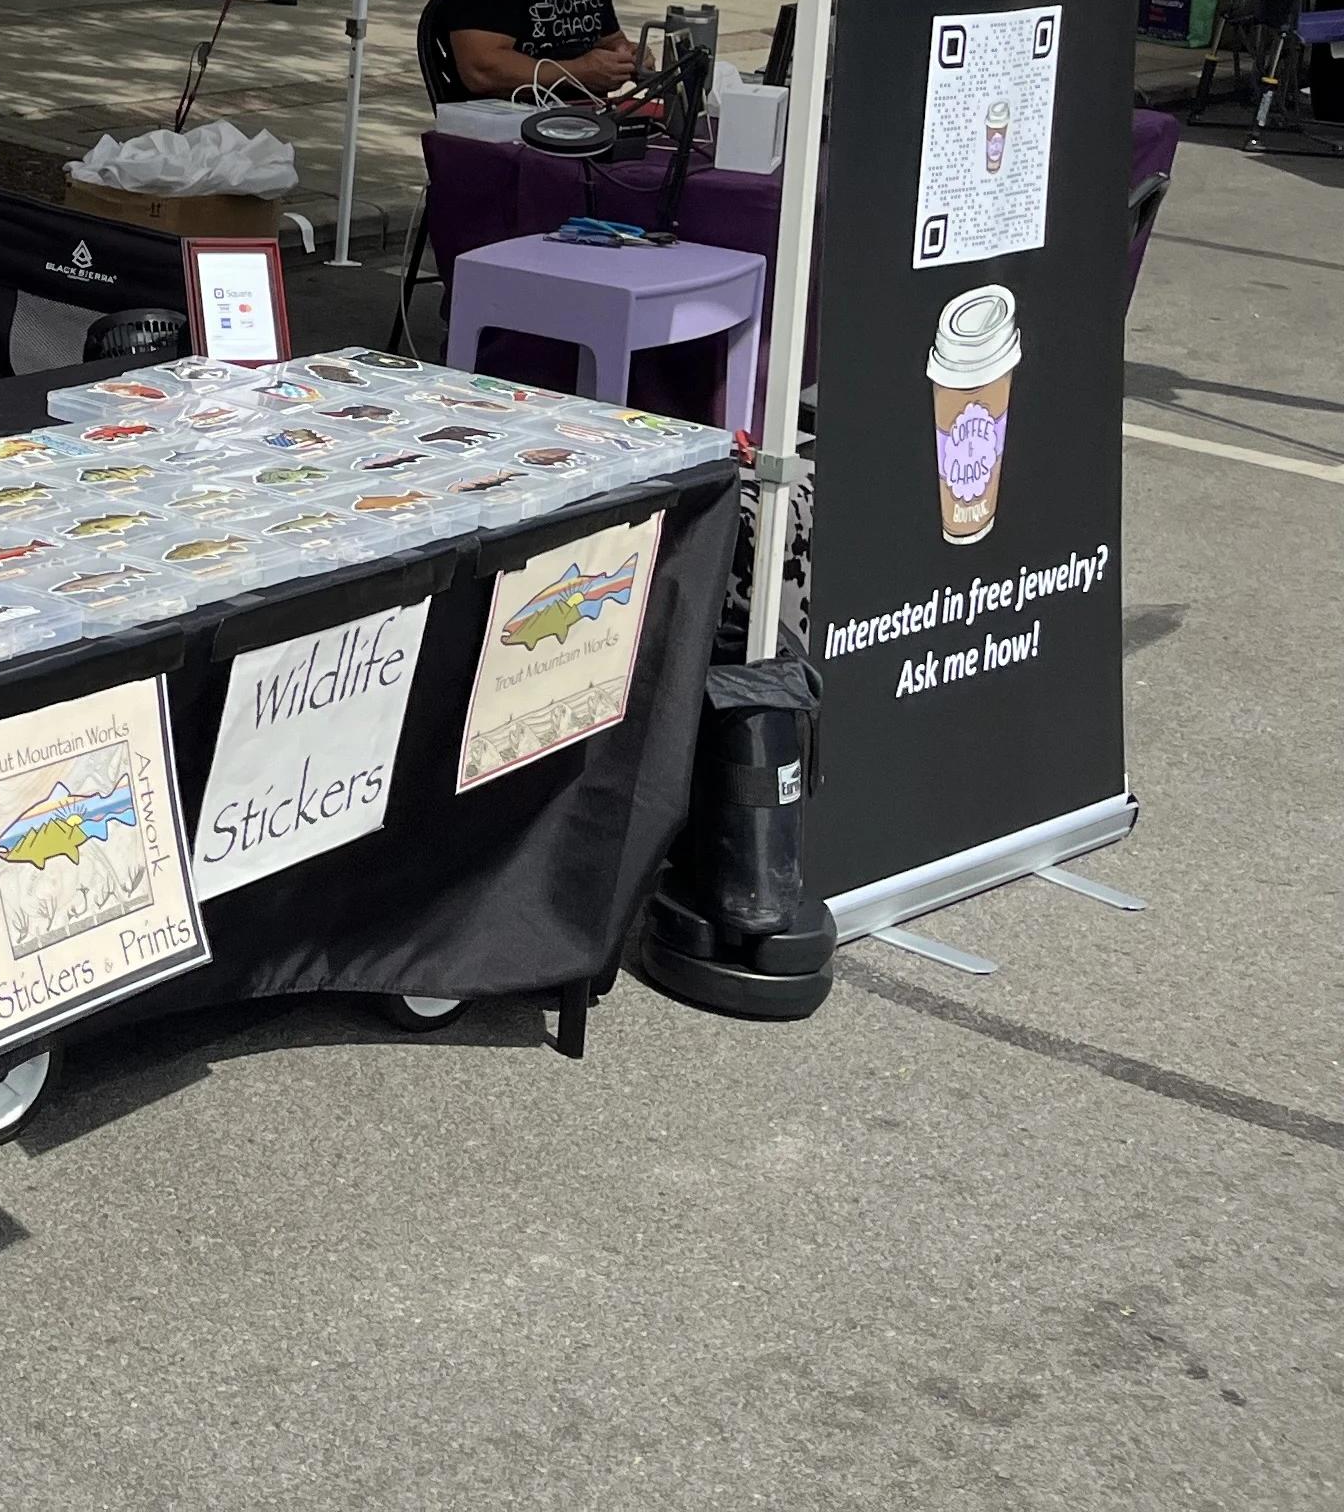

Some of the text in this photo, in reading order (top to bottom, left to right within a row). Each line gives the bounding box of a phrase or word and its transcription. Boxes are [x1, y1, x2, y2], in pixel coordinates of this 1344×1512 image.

[532, 12, 602, 38] & CHAOS
[45, 262, 76, 276] BLACK
[951, 418, 995, 446] COFFEE
[950, 456, 990, 485] CHAOS
[953, 499, 990, 524] BOUTIQUE
[824, 544, 1109, 660] Interested in free jewelry?
[256, 616, 405, 730] Wildlife
[495, 627, 620, 692] Trout Mountain Works
[895, 619, 1041, 699] Ask me how!
[16, 736, 85, 776] Mountain
[84, 714, 130, 746] Works
[133, 750, 171, 878] Artwork
[203, 755, 385, 863] Stickers
[118, 915, 191, 966] Prints
